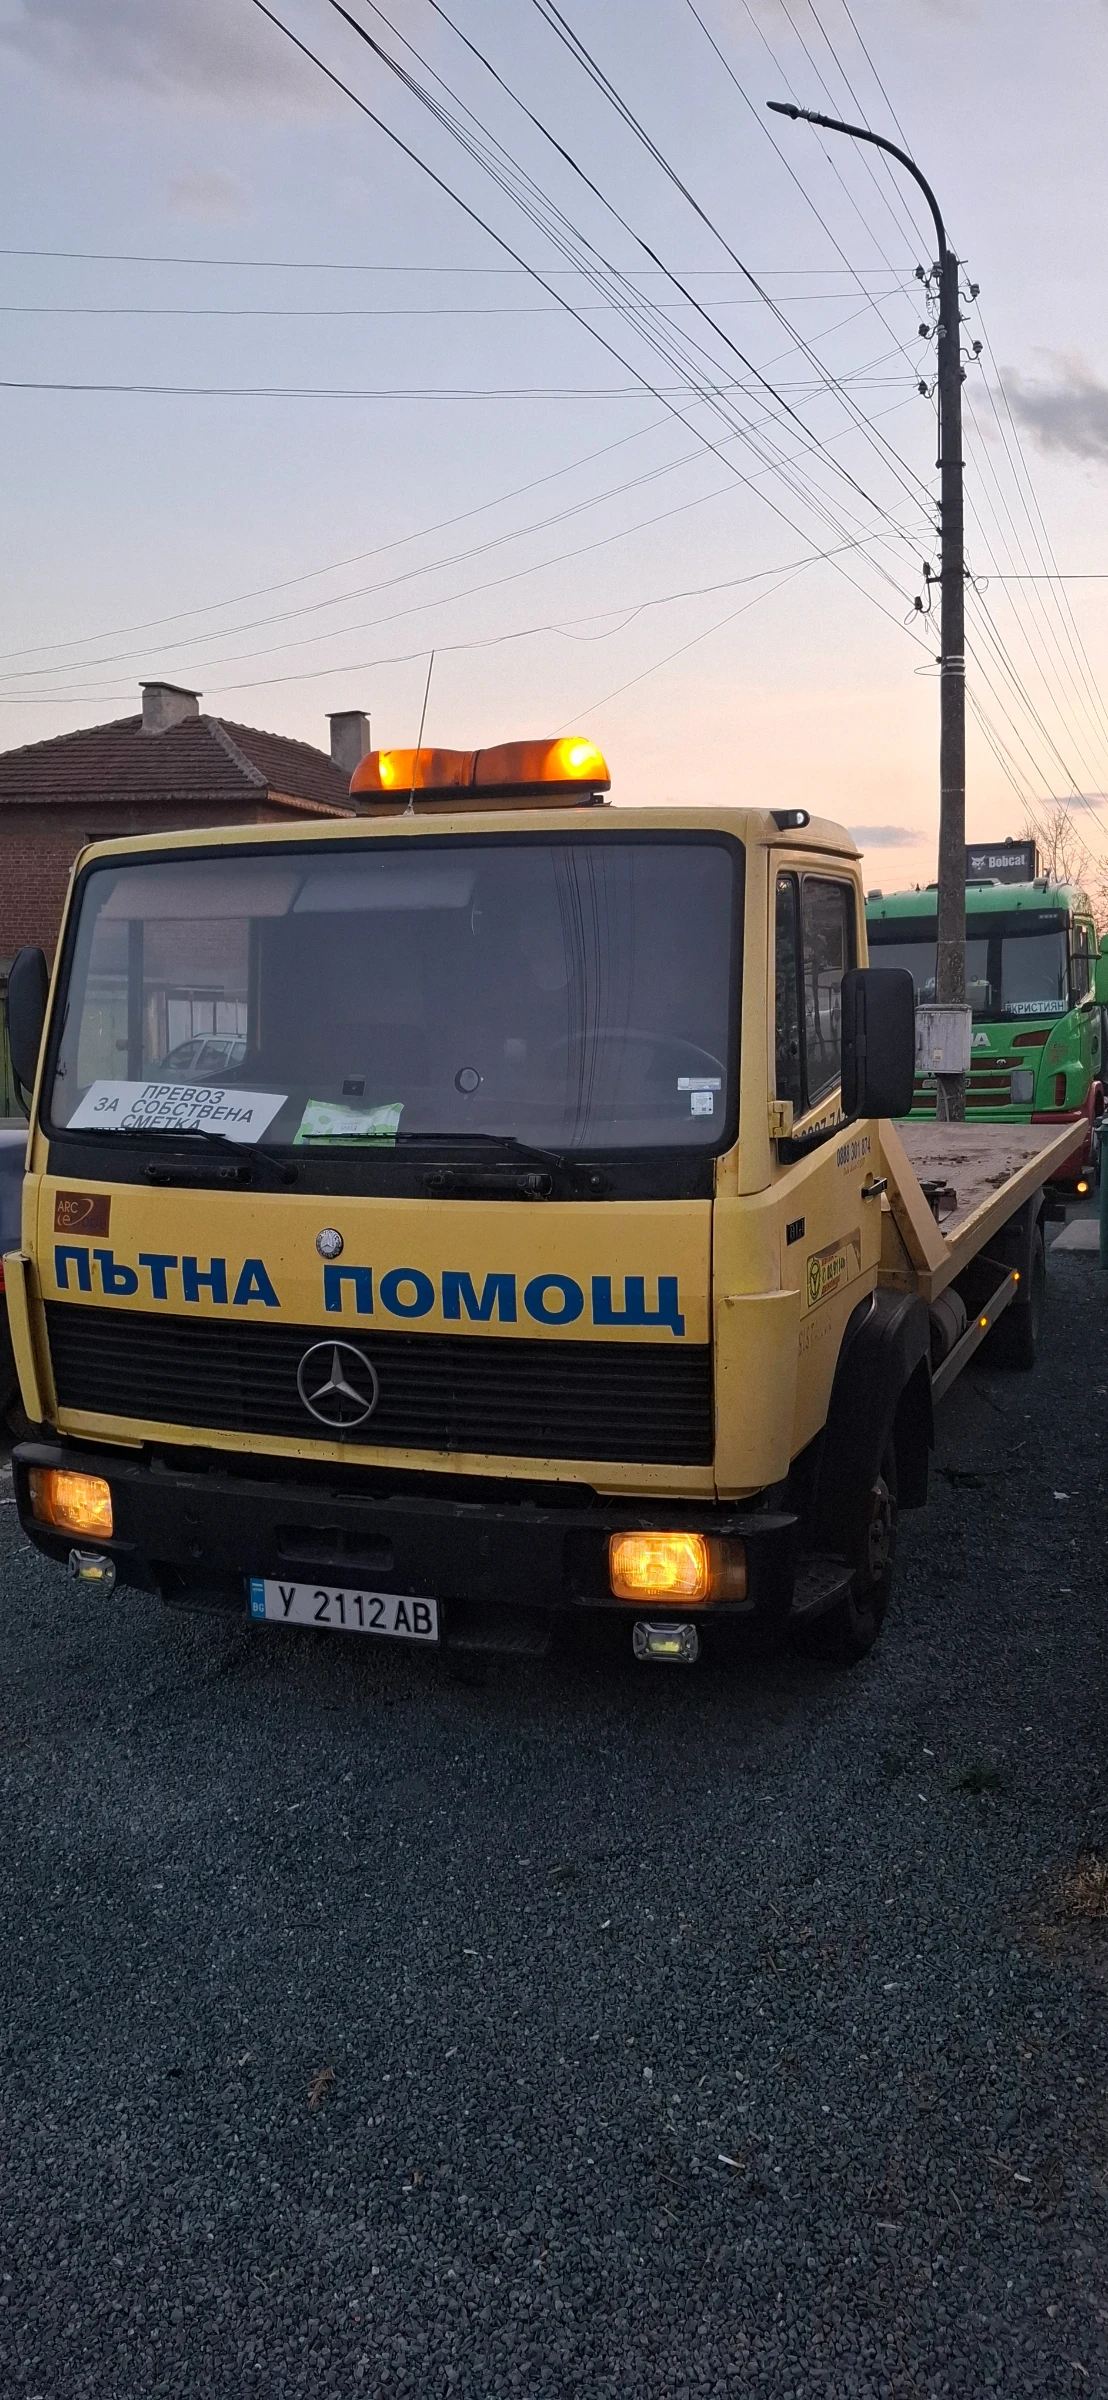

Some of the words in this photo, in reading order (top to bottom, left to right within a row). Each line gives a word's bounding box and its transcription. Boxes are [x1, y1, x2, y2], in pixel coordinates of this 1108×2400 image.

[988, 854, 1025, 868] Bobcat
[1012, 1002, 1064, 1013] КРИСТИЯН
[141, 1085, 225, 1105] ПРЕВОЗ
[93, 1097, 120, 1112] ЗА
[131, 1099, 254, 1123] СОБСТВЕНА
[57, 1200, 79, 1214] ARC
[54, 1245, 281, 1308] ПЪТНА
[323, 1264, 686, 1337] ПОМОЩ
[252, 1602, 264, 1612] BG
